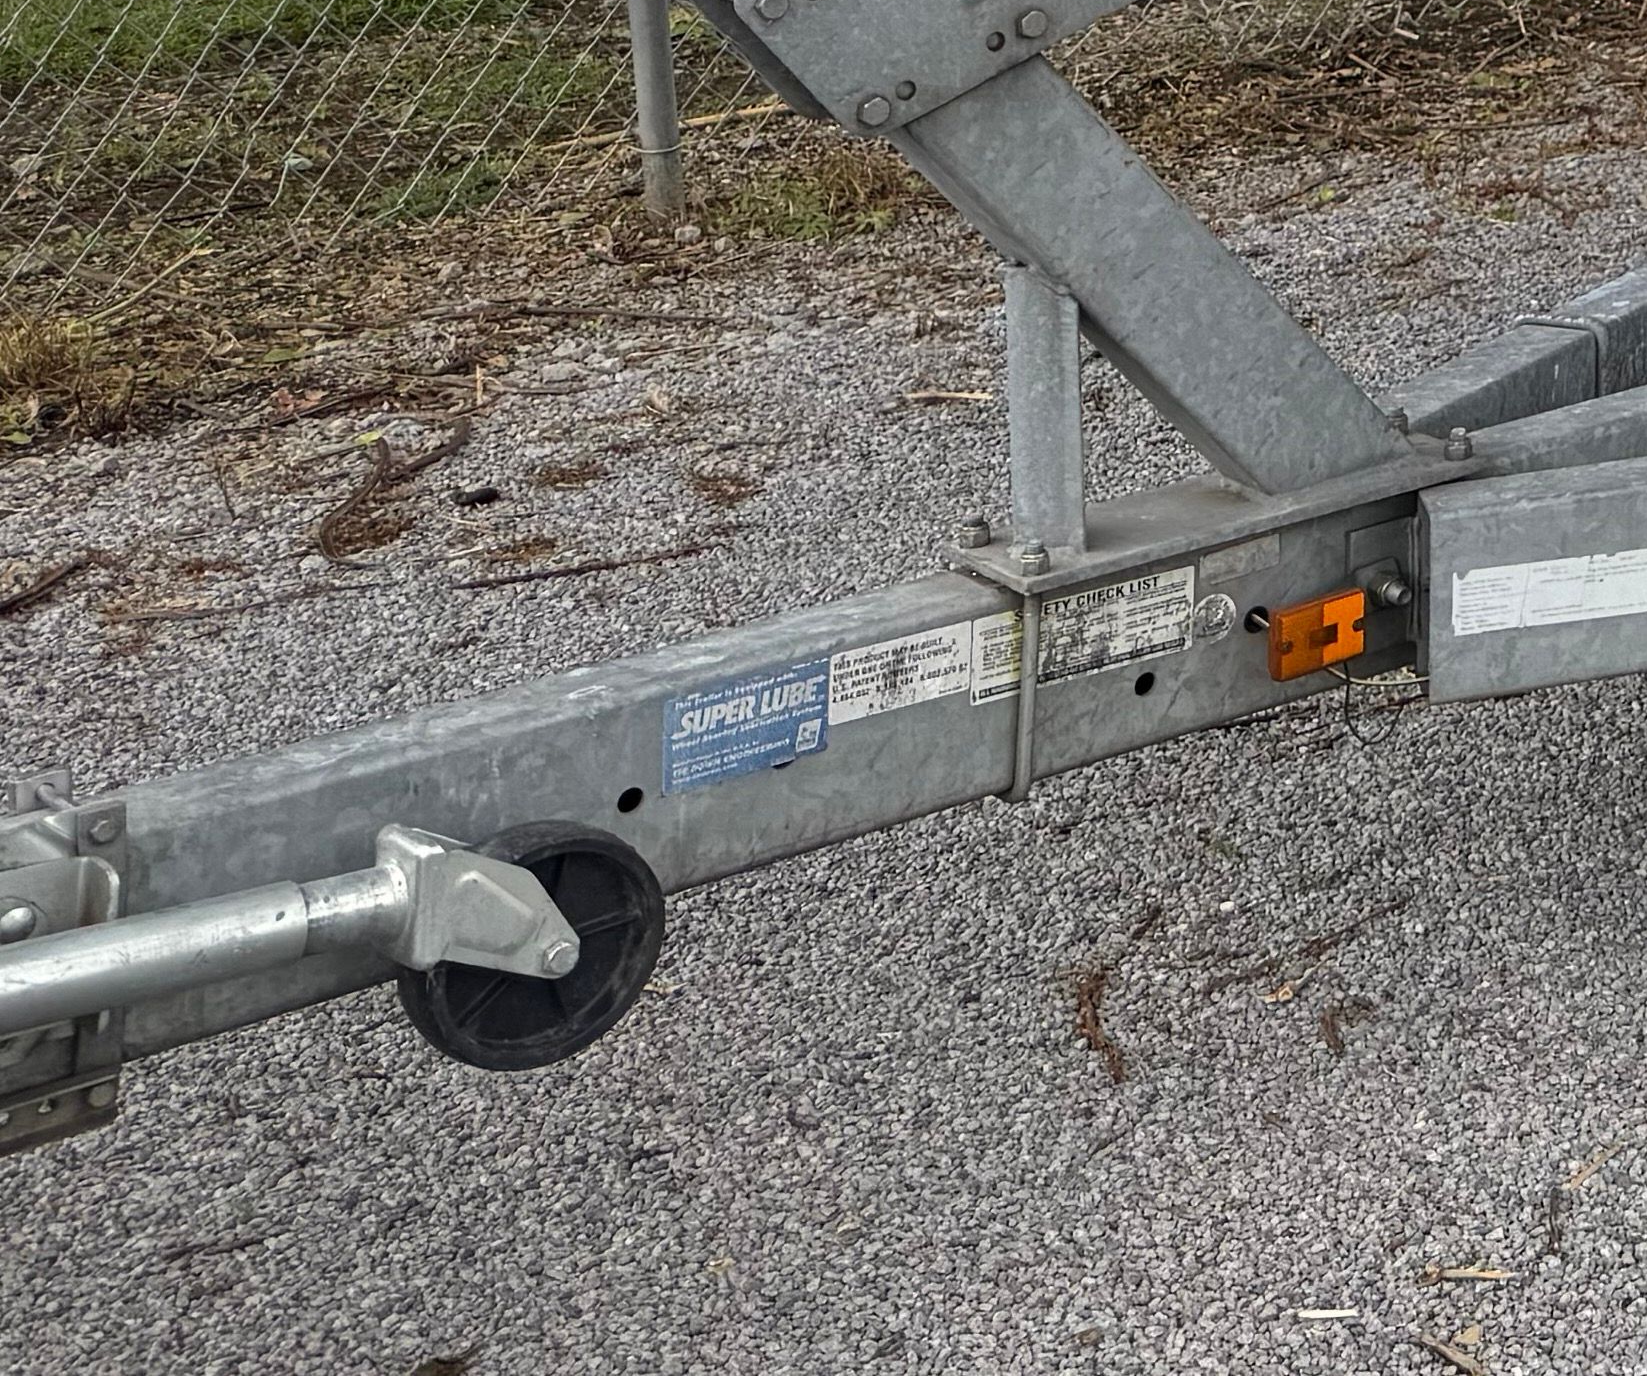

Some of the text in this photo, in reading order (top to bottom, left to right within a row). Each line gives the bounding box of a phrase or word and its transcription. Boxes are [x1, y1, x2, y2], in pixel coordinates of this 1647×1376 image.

[1015, 576, 1161, 623] SETY CHECK LIST
[671, 674, 827, 740] SUPER LUBE
